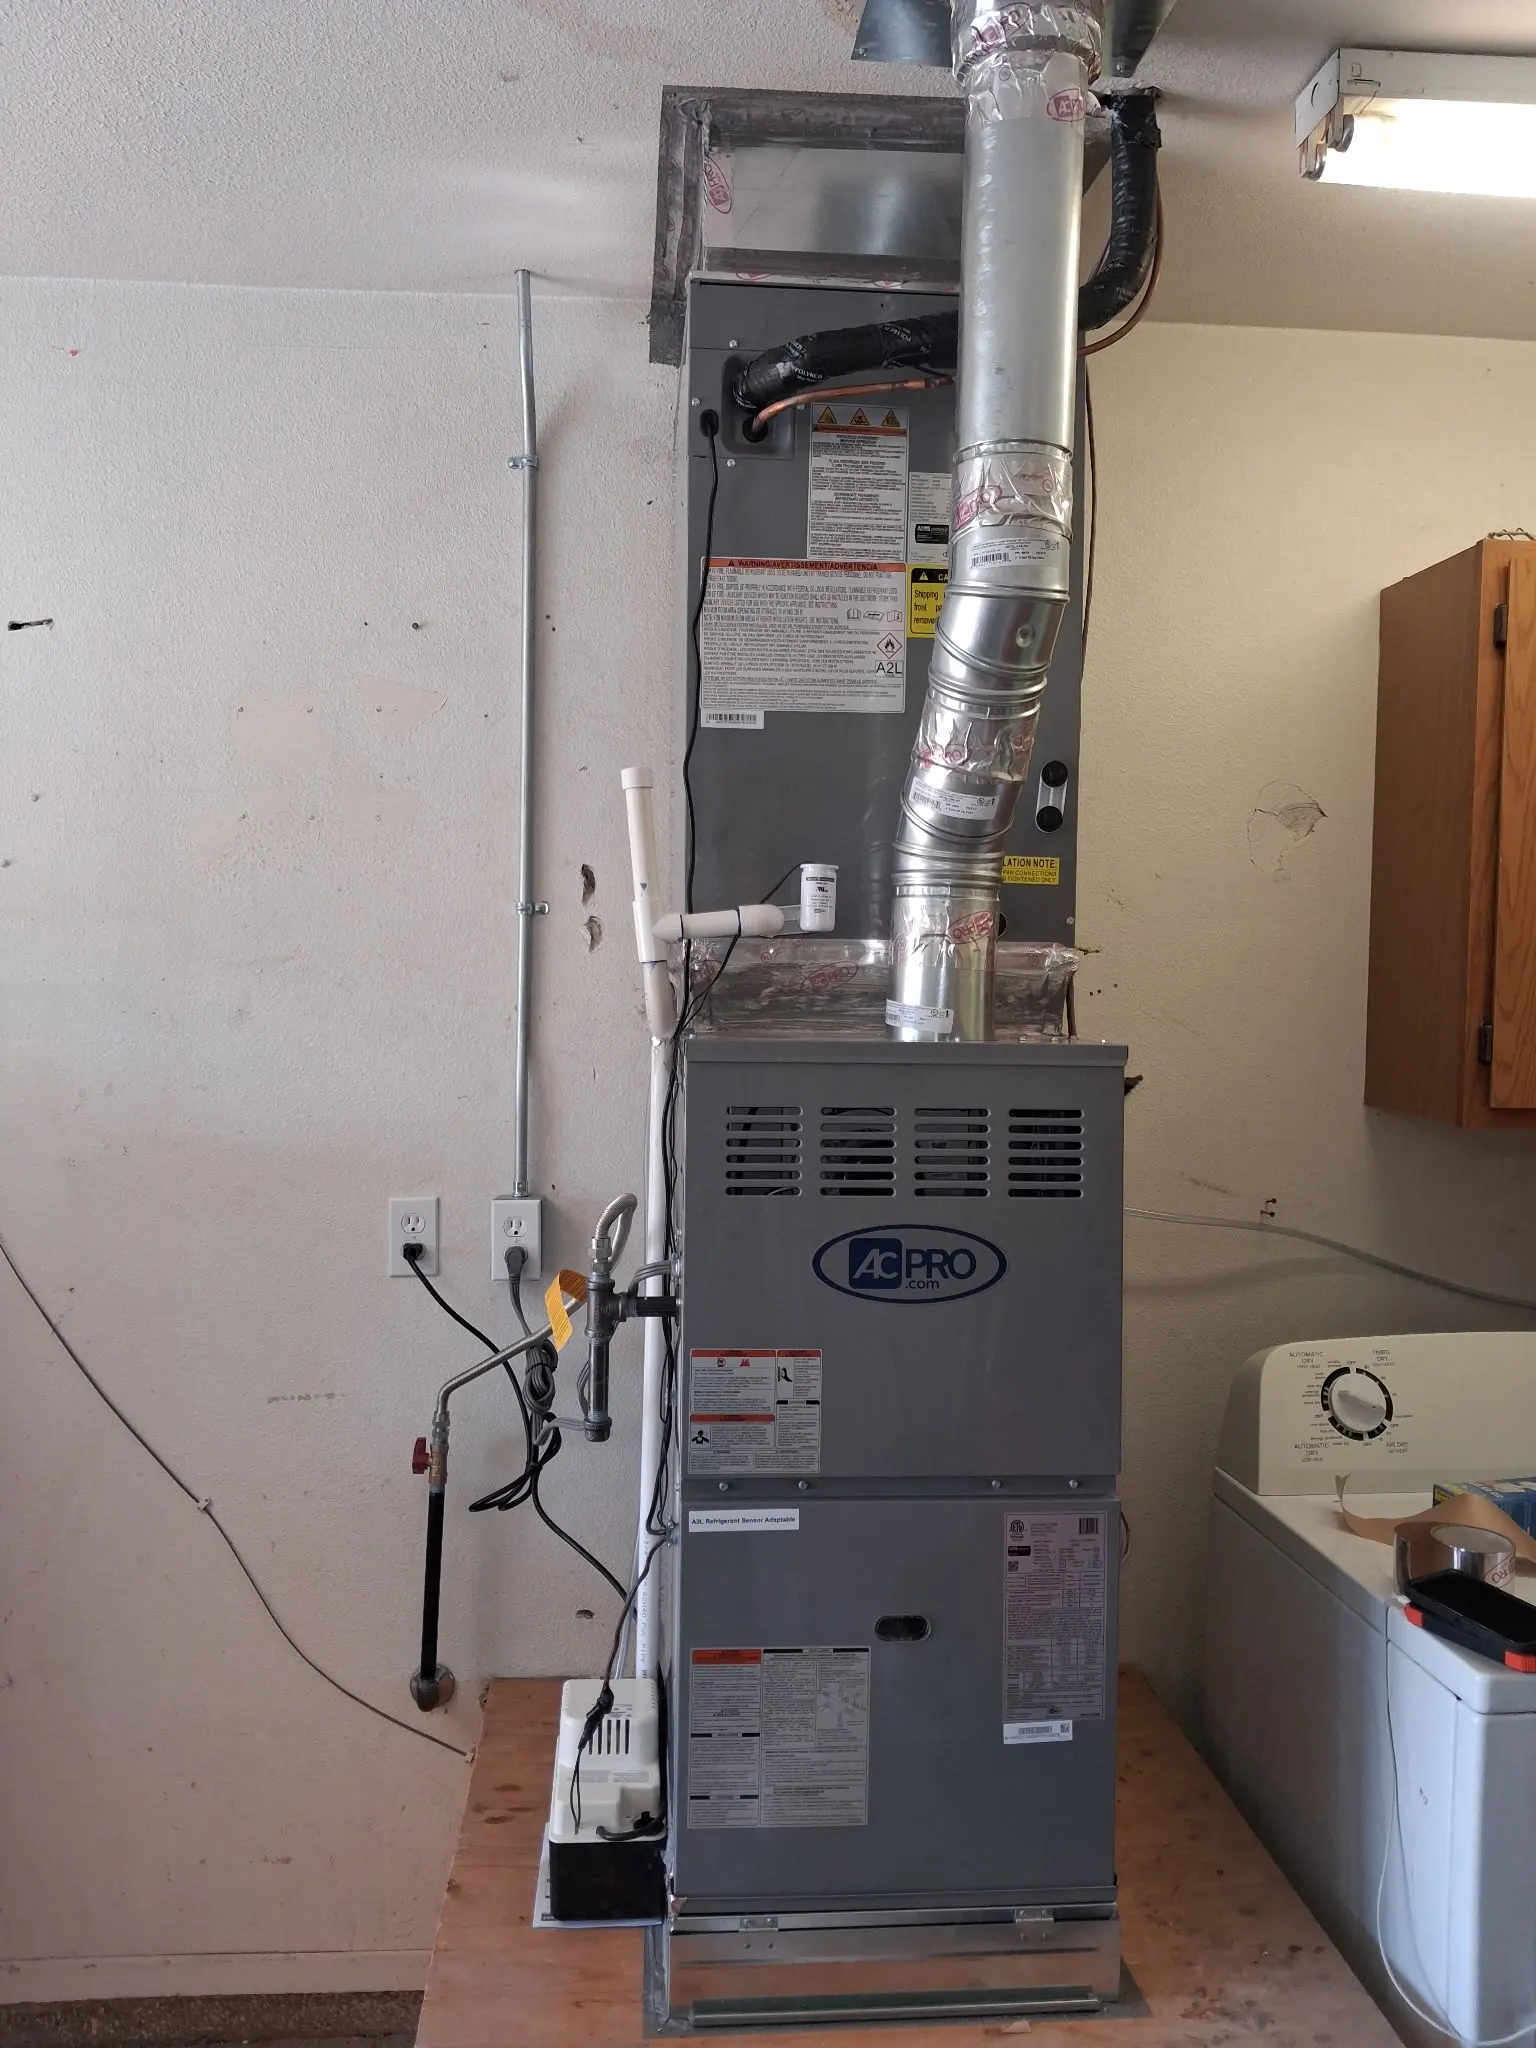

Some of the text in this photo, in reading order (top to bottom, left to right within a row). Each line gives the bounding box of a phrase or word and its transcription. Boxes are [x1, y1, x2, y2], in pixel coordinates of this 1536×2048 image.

[914, 589, 939, 600] Shipping
[914, 603, 927, 611] front
[876, 661, 903, 674] A2L
[1002, 858, 1031, 868] LATION
[853, 1247, 977, 1280] AC PRO
[905, 1279, 940, 1290] .com
[764, 1516, 796, 1524] Adaptable
